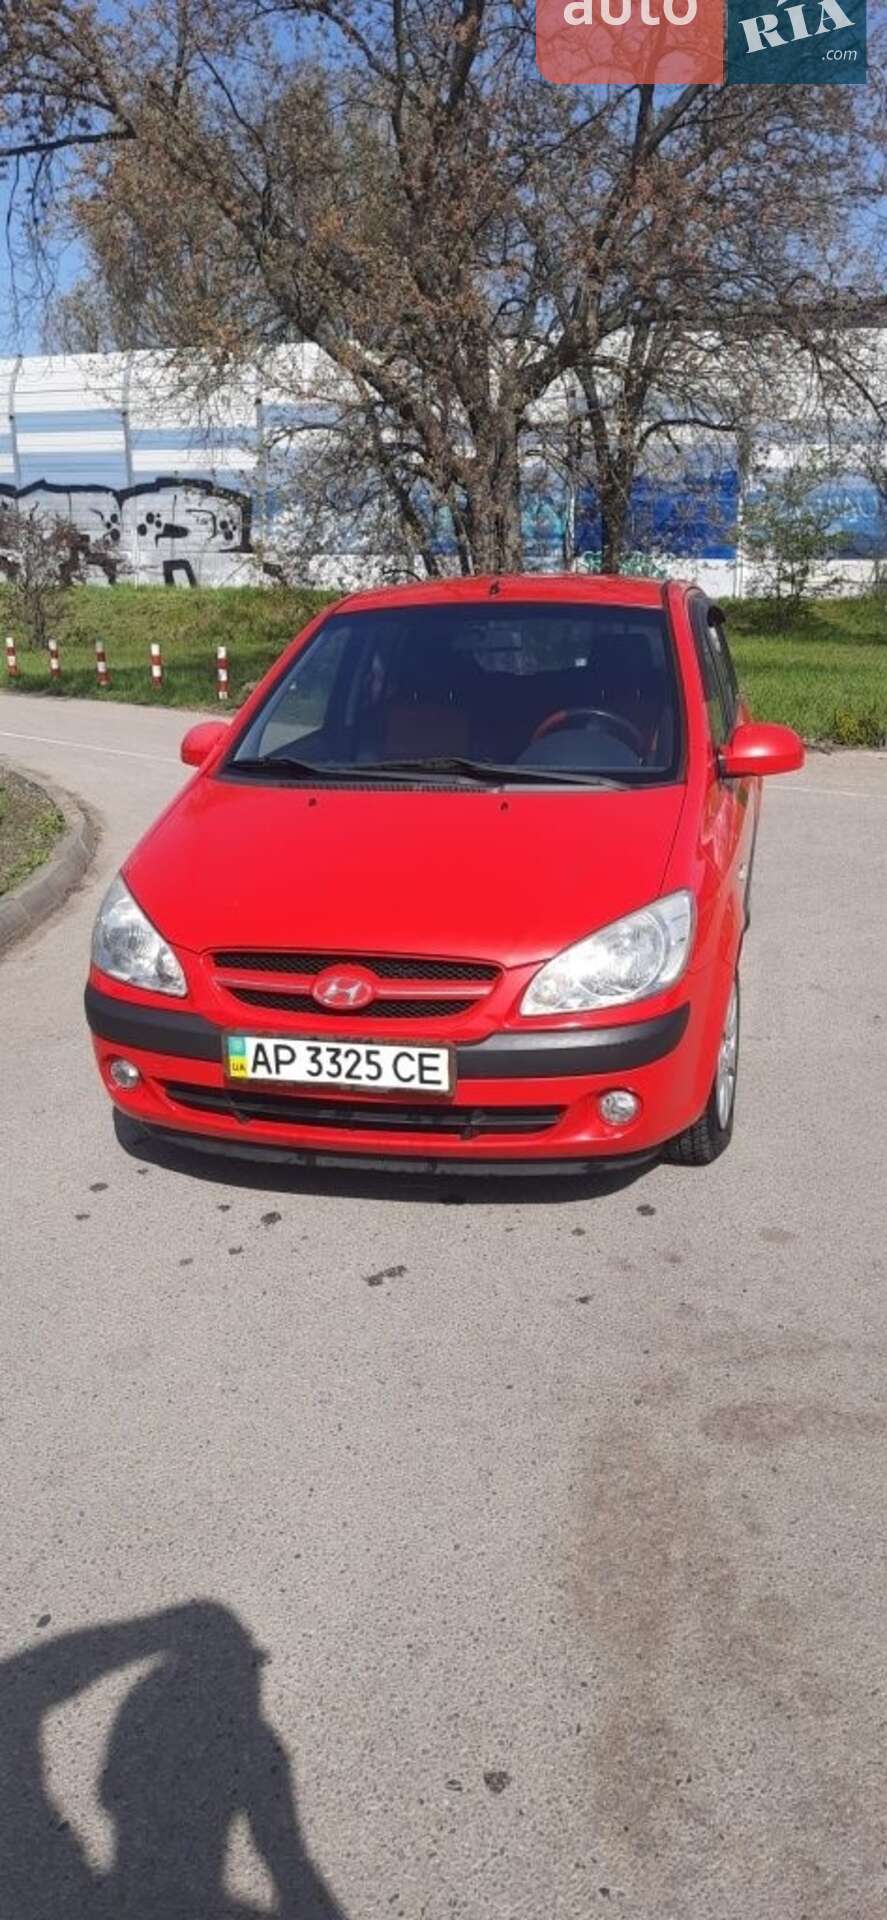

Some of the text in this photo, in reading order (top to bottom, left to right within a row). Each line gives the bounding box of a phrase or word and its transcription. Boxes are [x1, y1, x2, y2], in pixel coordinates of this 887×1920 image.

[232, 1063, 246, 1072] UA
[251, 1043, 442, 1085] AP 3325 CE
